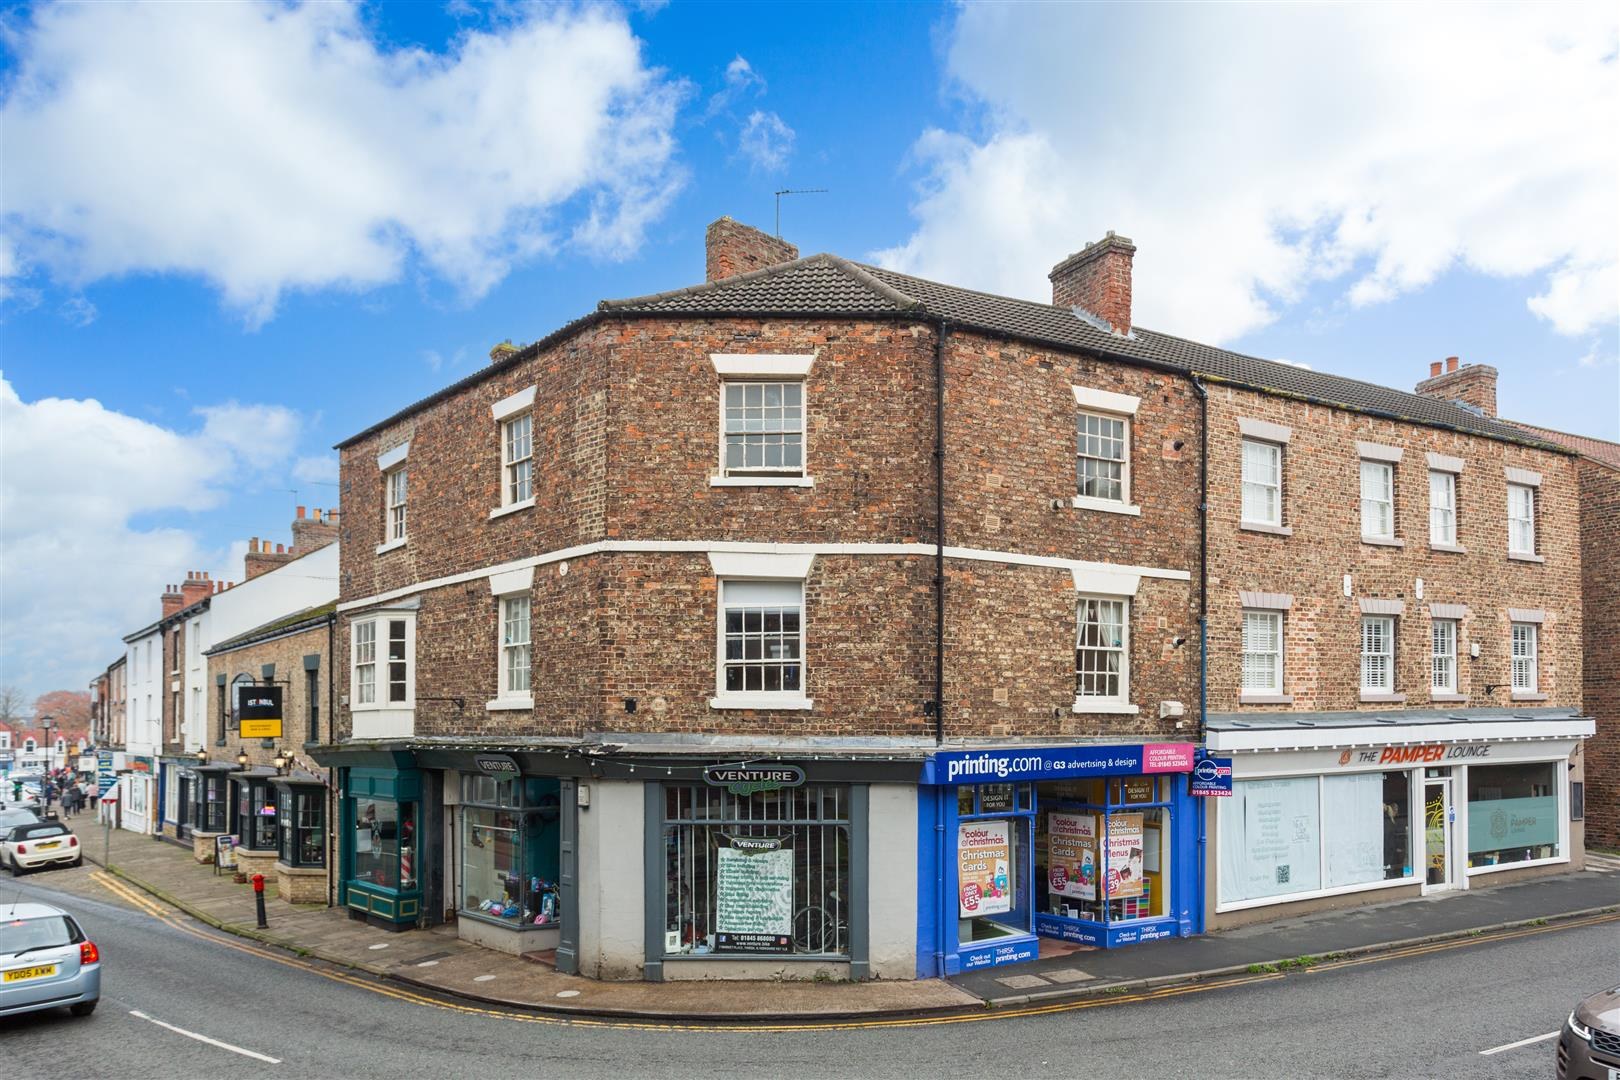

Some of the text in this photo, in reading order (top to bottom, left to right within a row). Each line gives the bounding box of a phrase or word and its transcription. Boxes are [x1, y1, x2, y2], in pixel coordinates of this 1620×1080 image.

[1359, 744, 1491, 764] THE PAMPER LOUNGE
[479, 760, 515, 770] VENTURE
[948, 753, 1042, 782] printing.com
[1053, 760, 1066, 770] G3
[1067, 758, 1107, 770] advertising
[1107, 758, 1114, 767] &
[1114, 757, 1137, 768] design
[715, 771, 792, 780] VENTURE
[1055, 818, 1078, 827] colour
[965, 829, 989, 839] colour
[1058, 825, 1092, 836] christmas
[968, 834, 1004, 846] christmas
[1051, 836, 1092, 848] Christmas
[961, 849, 1006, 861] Christmas
[1051, 846, 1076, 858] Cards
[961, 860, 988, 872] Cards
[1052, 877, 1068, 887] £55
[963, 894, 981, 908] £55
[996, 946, 1014, 956] THIRSK
